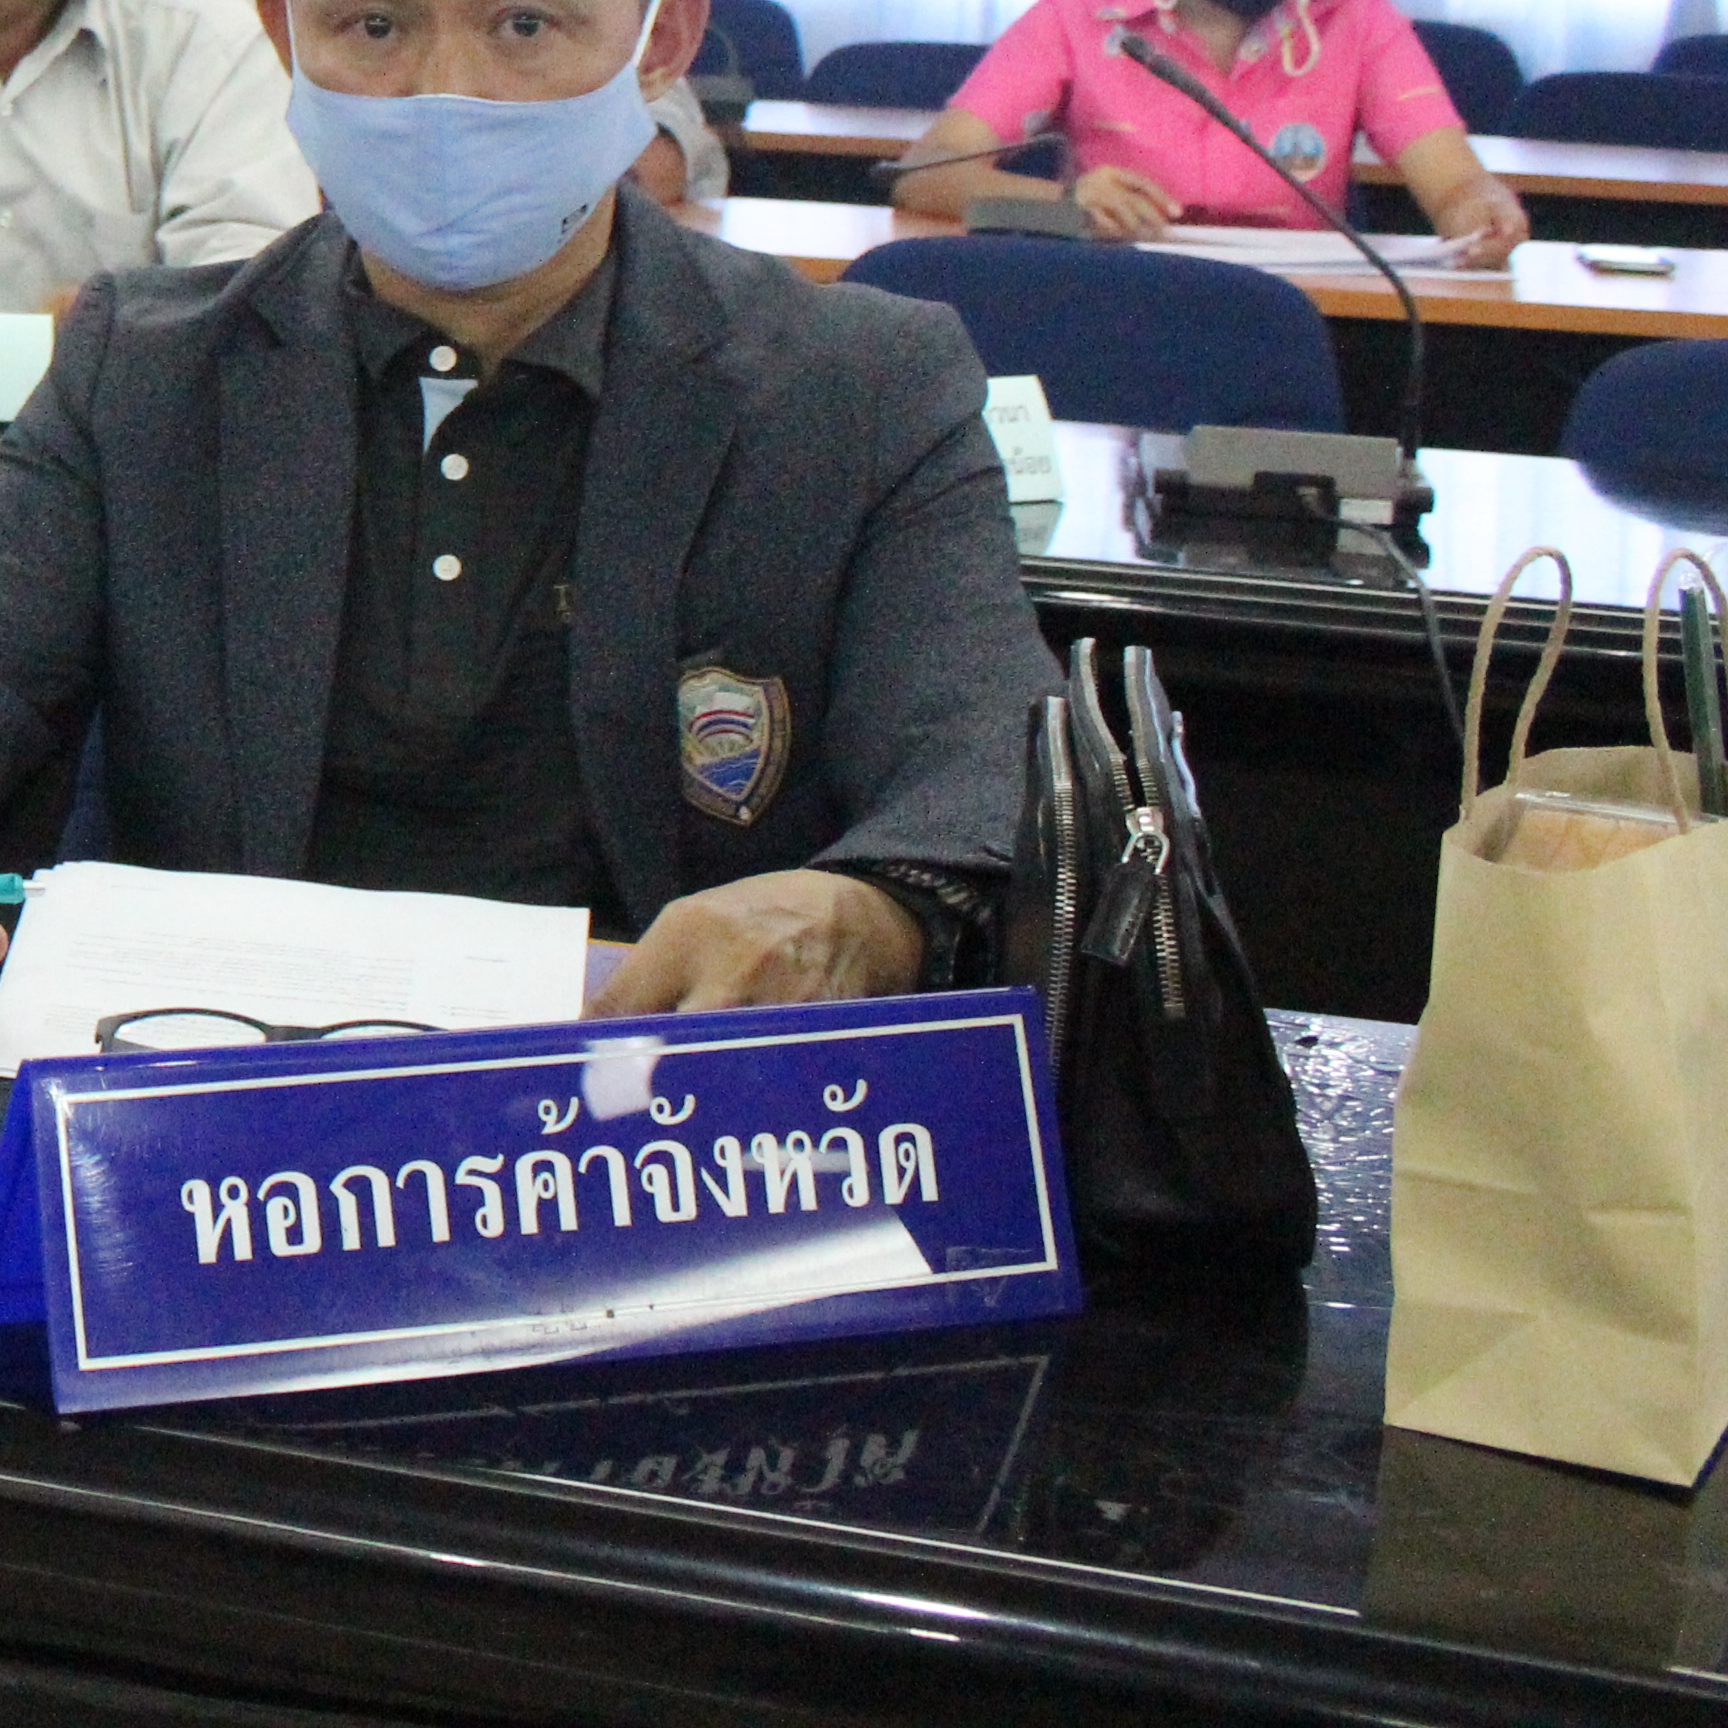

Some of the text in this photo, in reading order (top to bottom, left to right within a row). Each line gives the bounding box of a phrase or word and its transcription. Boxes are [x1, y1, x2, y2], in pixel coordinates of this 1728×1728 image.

[179, 1077, 940, 1265] หอการค้าจังหวัด
